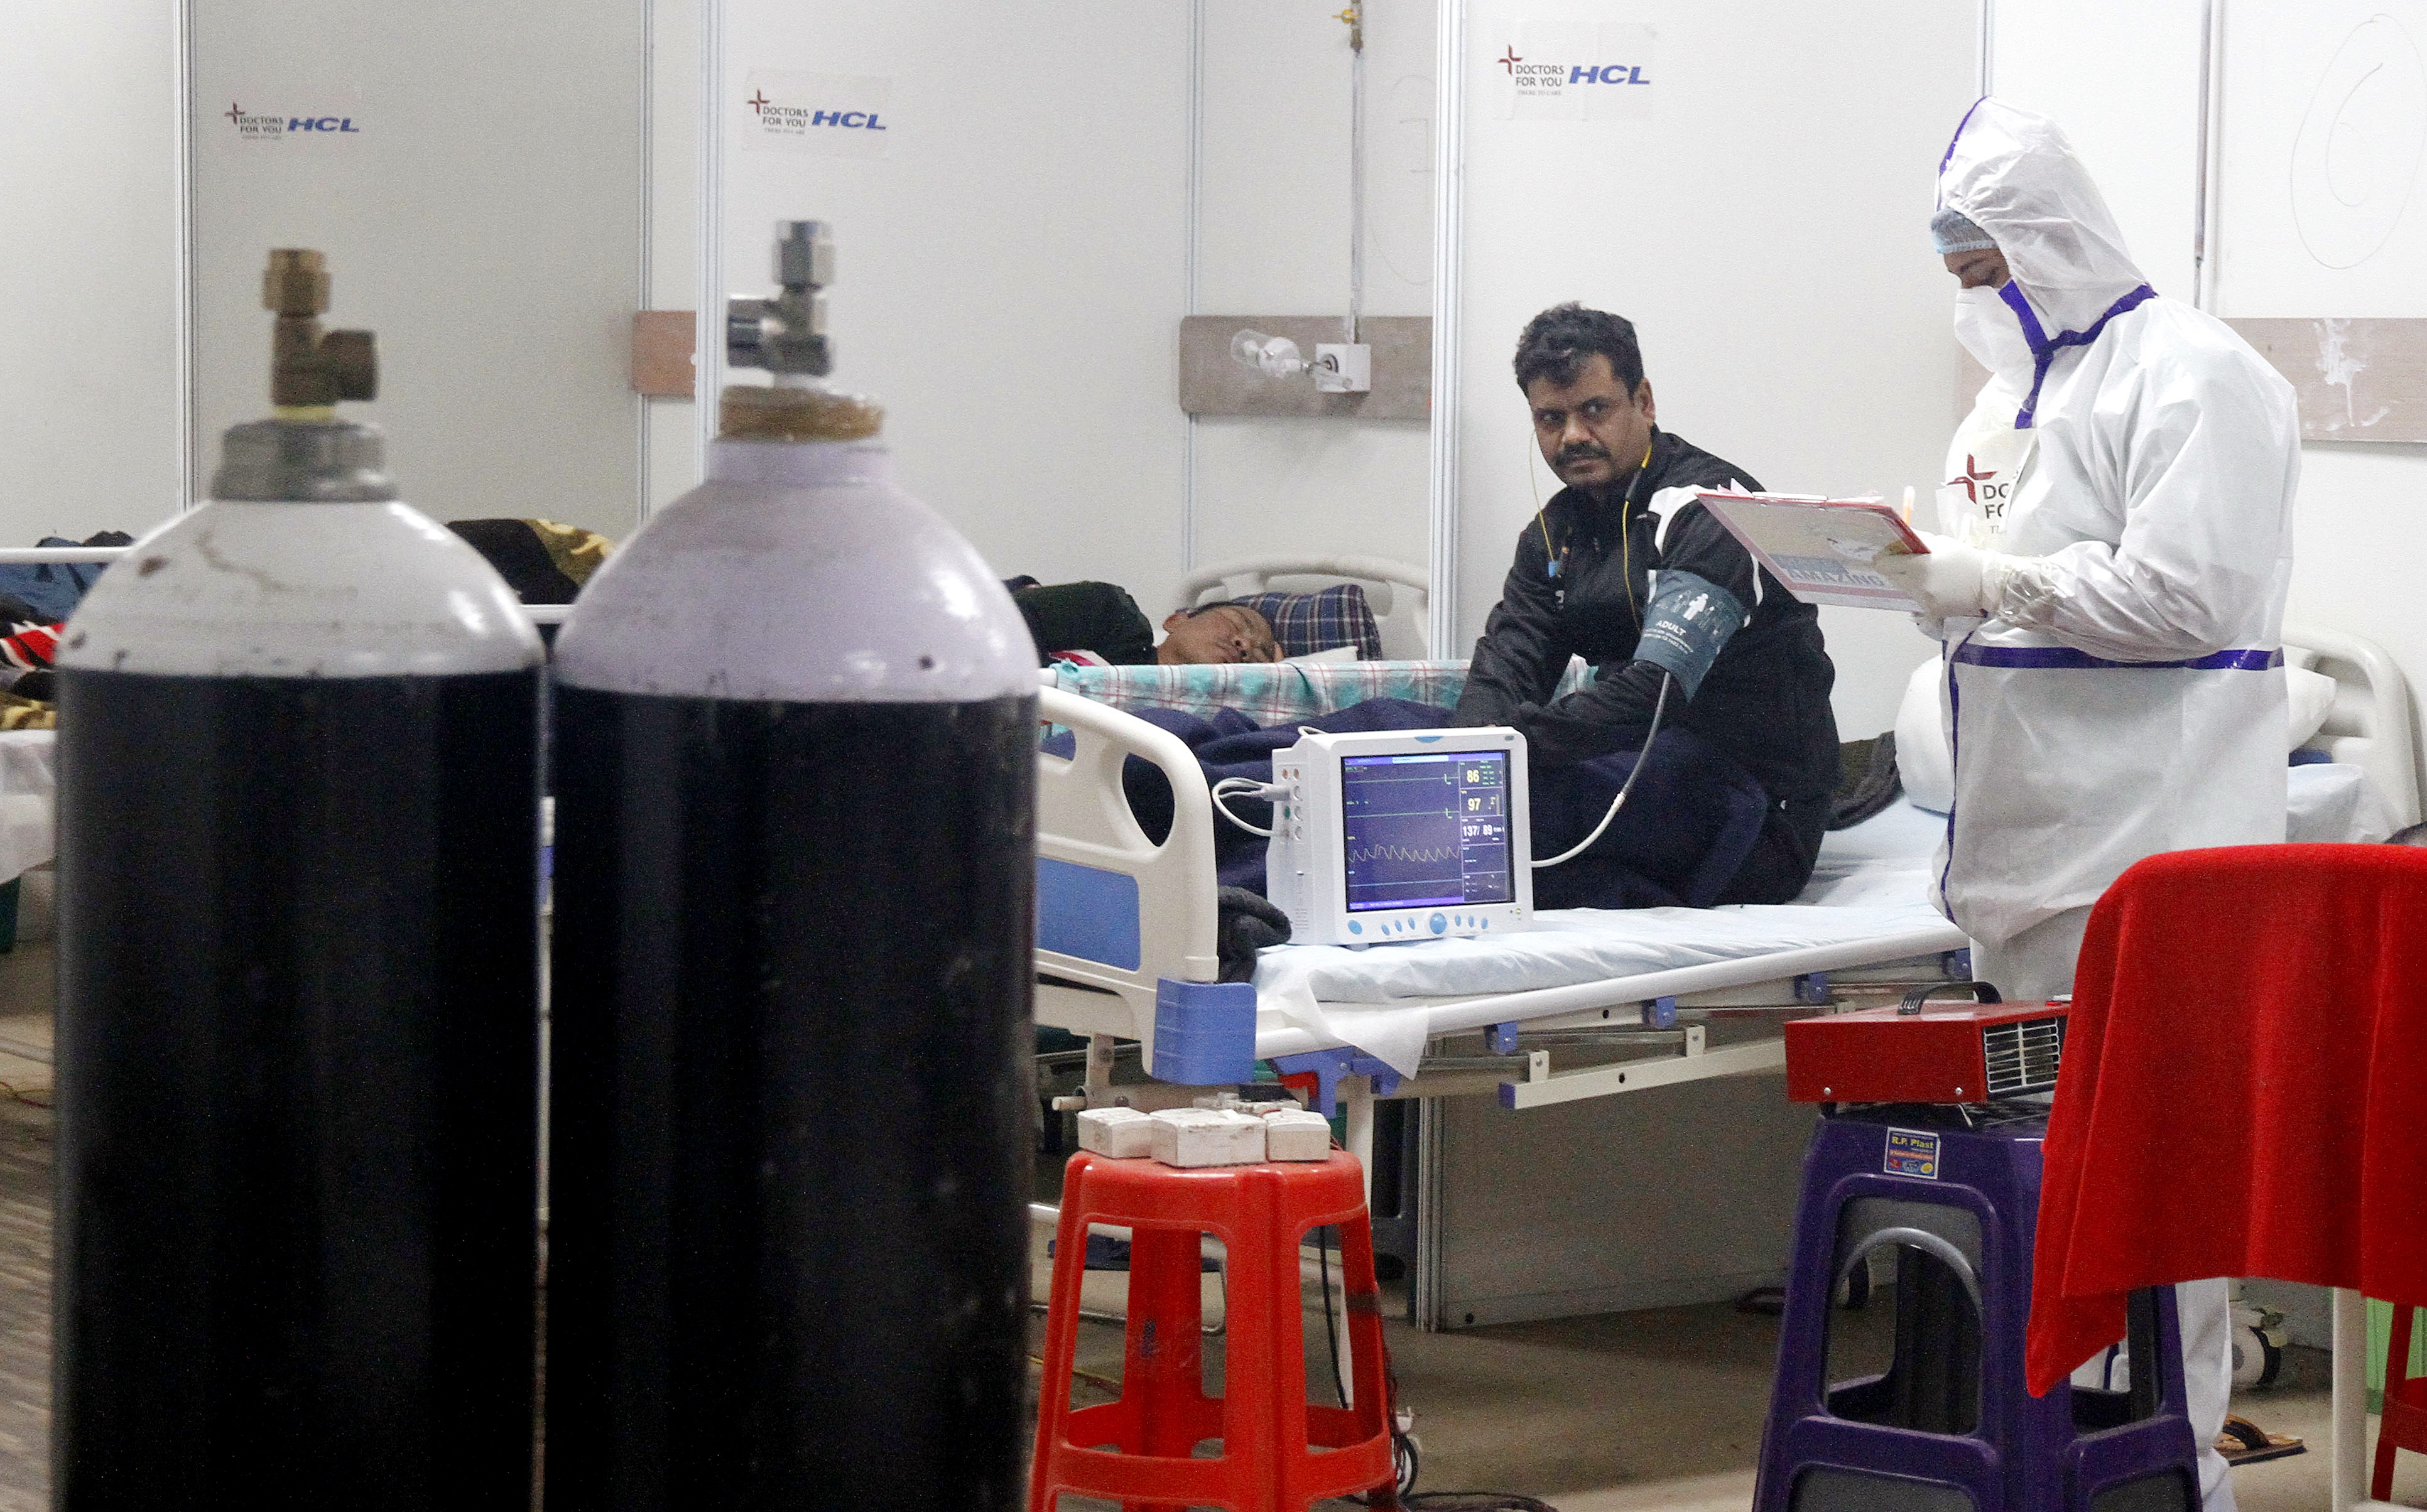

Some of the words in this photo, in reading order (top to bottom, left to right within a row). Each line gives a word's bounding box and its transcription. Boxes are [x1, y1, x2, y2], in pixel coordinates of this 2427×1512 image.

[1516, 65, 1564, 74] DOCTORS
[1569, 65, 1651, 84] HCL
[1516, 77, 1536, 85] FOR
[1541, 77, 1561, 86] YOU
[763, 105, 808, 117] DOCTORS
[240, 116, 283, 124] DOCTORS
[288, 117, 359, 132] HCL
[763, 117, 781, 125] FOR
[786, 118, 806, 127] YOU
[812, 111, 886, 130] HCL
[1656, 620, 1686, 635] ADULT
[1467, 770, 1480, 783] 86
[1468, 797, 1481, 811] 97
[1910, 1138, 1934, 1148] Plast
